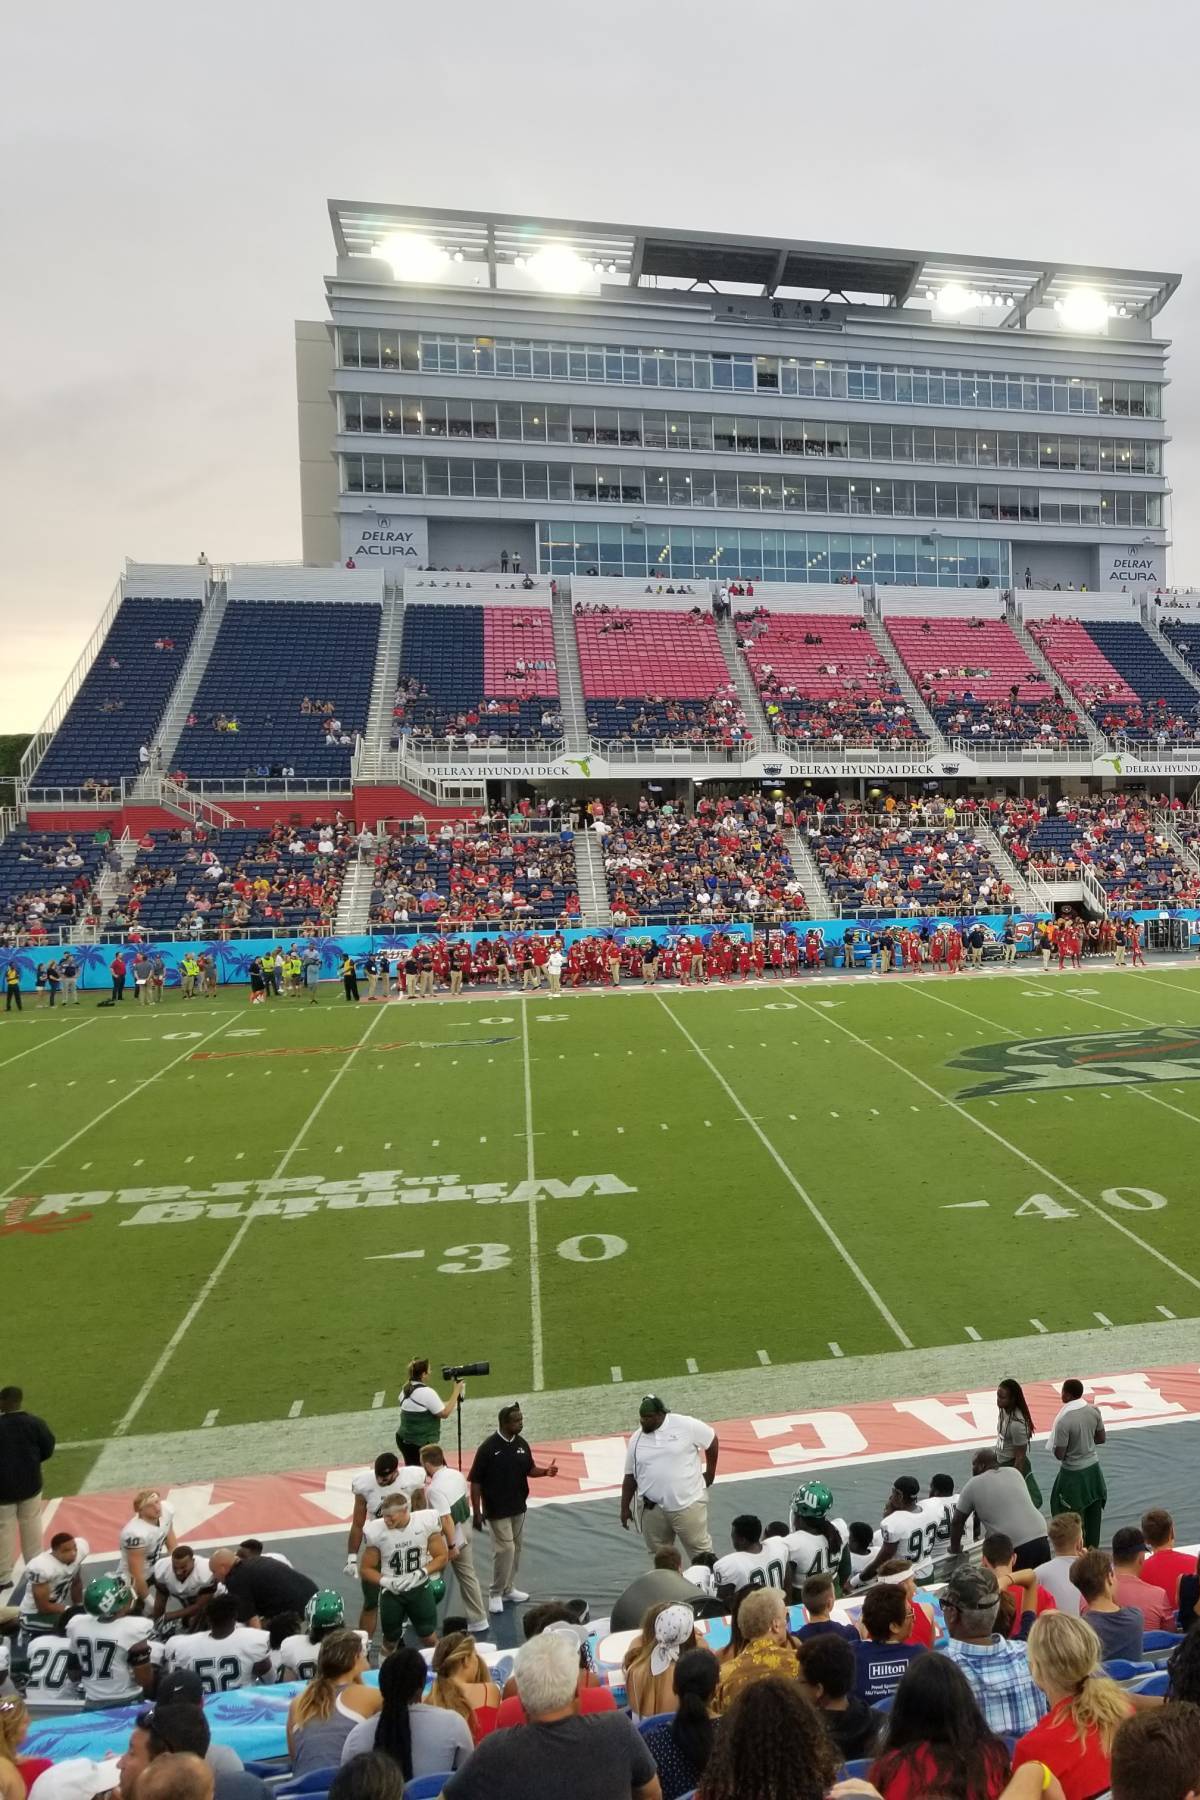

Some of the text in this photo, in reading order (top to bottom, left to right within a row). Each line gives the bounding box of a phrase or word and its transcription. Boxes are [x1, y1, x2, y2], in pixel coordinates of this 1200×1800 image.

[362, 531, 413, 541] DELRAY
[355, 545, 418, 556] ACURA
[1113, 559, 1153, 568] DELRAY
[1109, 572, 1157, 581] ACURA
[428, 767, 569, 776] DELRAY HYUNDAI DECK
[790, 765, 839, 775] DELRAY
[841, 765, 898, 775] HYUNDAI
[902, 764, 934, 774] DECK
[1125, 765, 1163, 774] DELRAY
[400, 1174, 460, 1186] in
[119, 1174, 638, 1226] Winning
[908, 1522, 938, 1562] 93
[388, 1547, 421, 1577] 48
[76, 1638, 118, 1679] 37
[27, 1650, 69, 1689] 20
[194, 1656, 243, 1694] 52
[872, 1665, 906, 1676] Hilton
